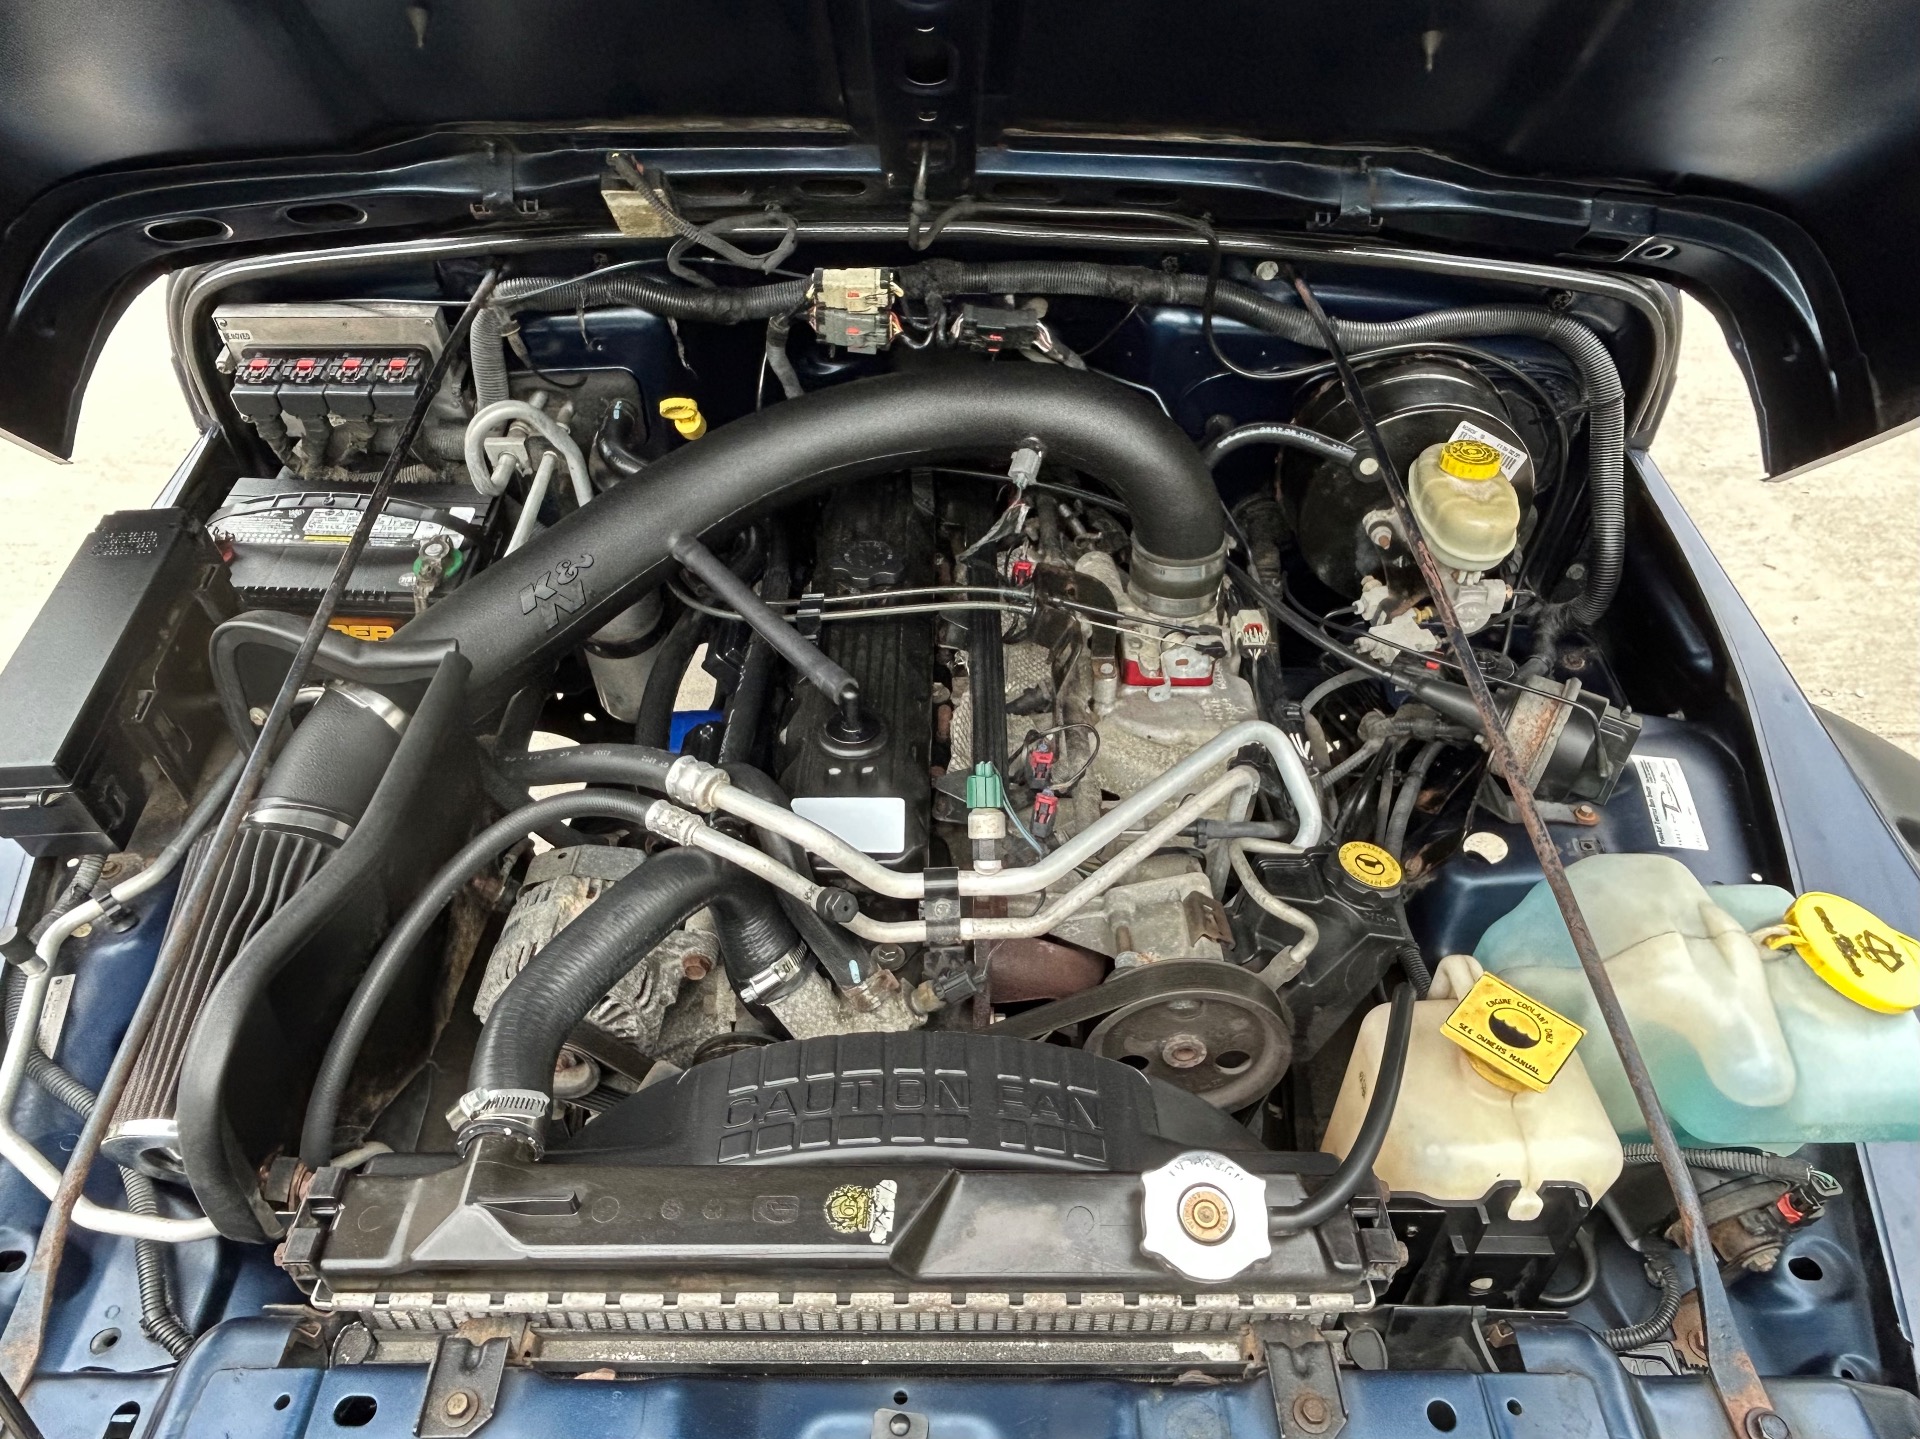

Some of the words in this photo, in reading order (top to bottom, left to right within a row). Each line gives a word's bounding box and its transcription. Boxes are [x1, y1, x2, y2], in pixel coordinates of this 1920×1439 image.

[519, 554, 594, 633] K&N
[1516, 1001, 1549, 1025] COOLANT
[1458, 1022, 1474, 1035] SEE
[1509, 1053, 1540, 1076] MANUAL
[723, 1079, 970, 1129] CAUTION
[998, 1085, 1105, 1131] FAN
